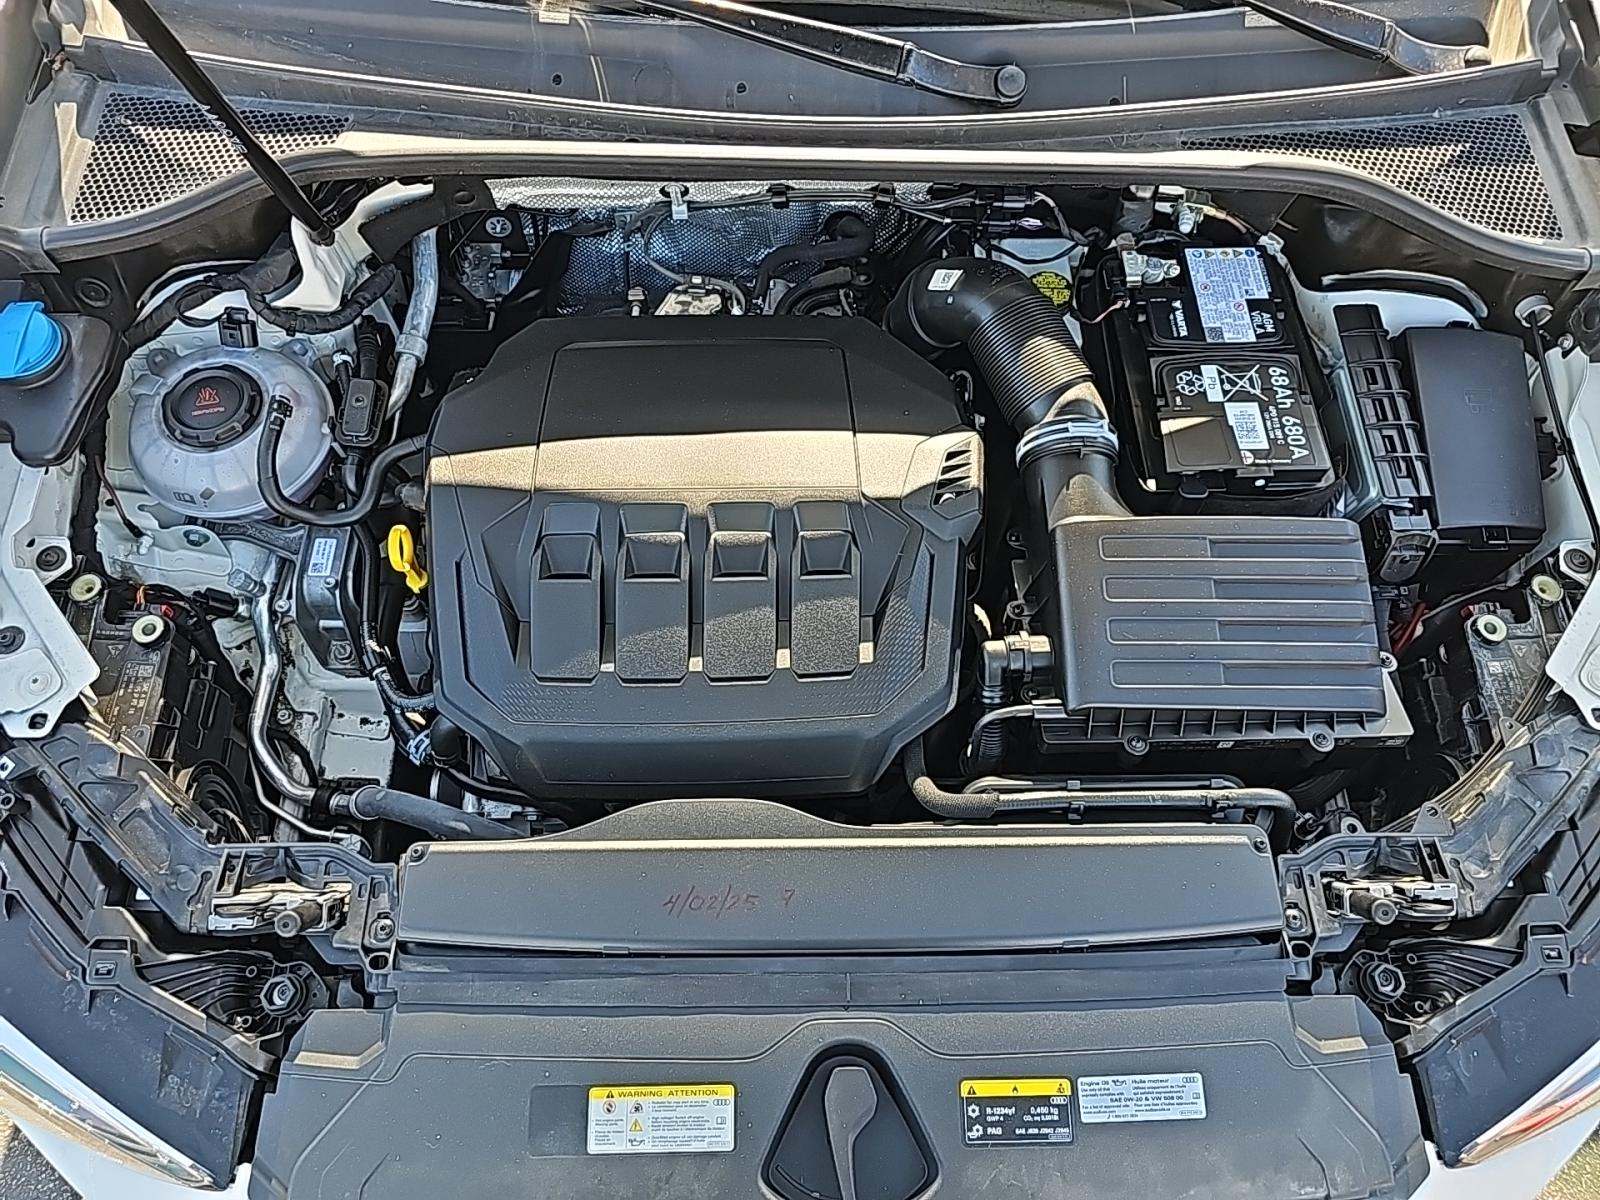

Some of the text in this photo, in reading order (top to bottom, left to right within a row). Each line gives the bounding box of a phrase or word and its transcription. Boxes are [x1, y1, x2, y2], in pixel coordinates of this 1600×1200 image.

[1175, 309, 1188, 337] VARTA
[1250, 310, 1266, 335] VRLA
[1260, 312, 1276, 333] AGM
[1206, 376, 1217, 390] Pb
[1268, 366, 1310, 460] 68Ah 680A
[618, 1088, 719, 1098] WARNING ATTENTION
[986, 1106, 1016, 1116] R-1234yf
[1049, 1106, 1059, 1115] kg
[986, 1127, 1003, 1135] PAG
